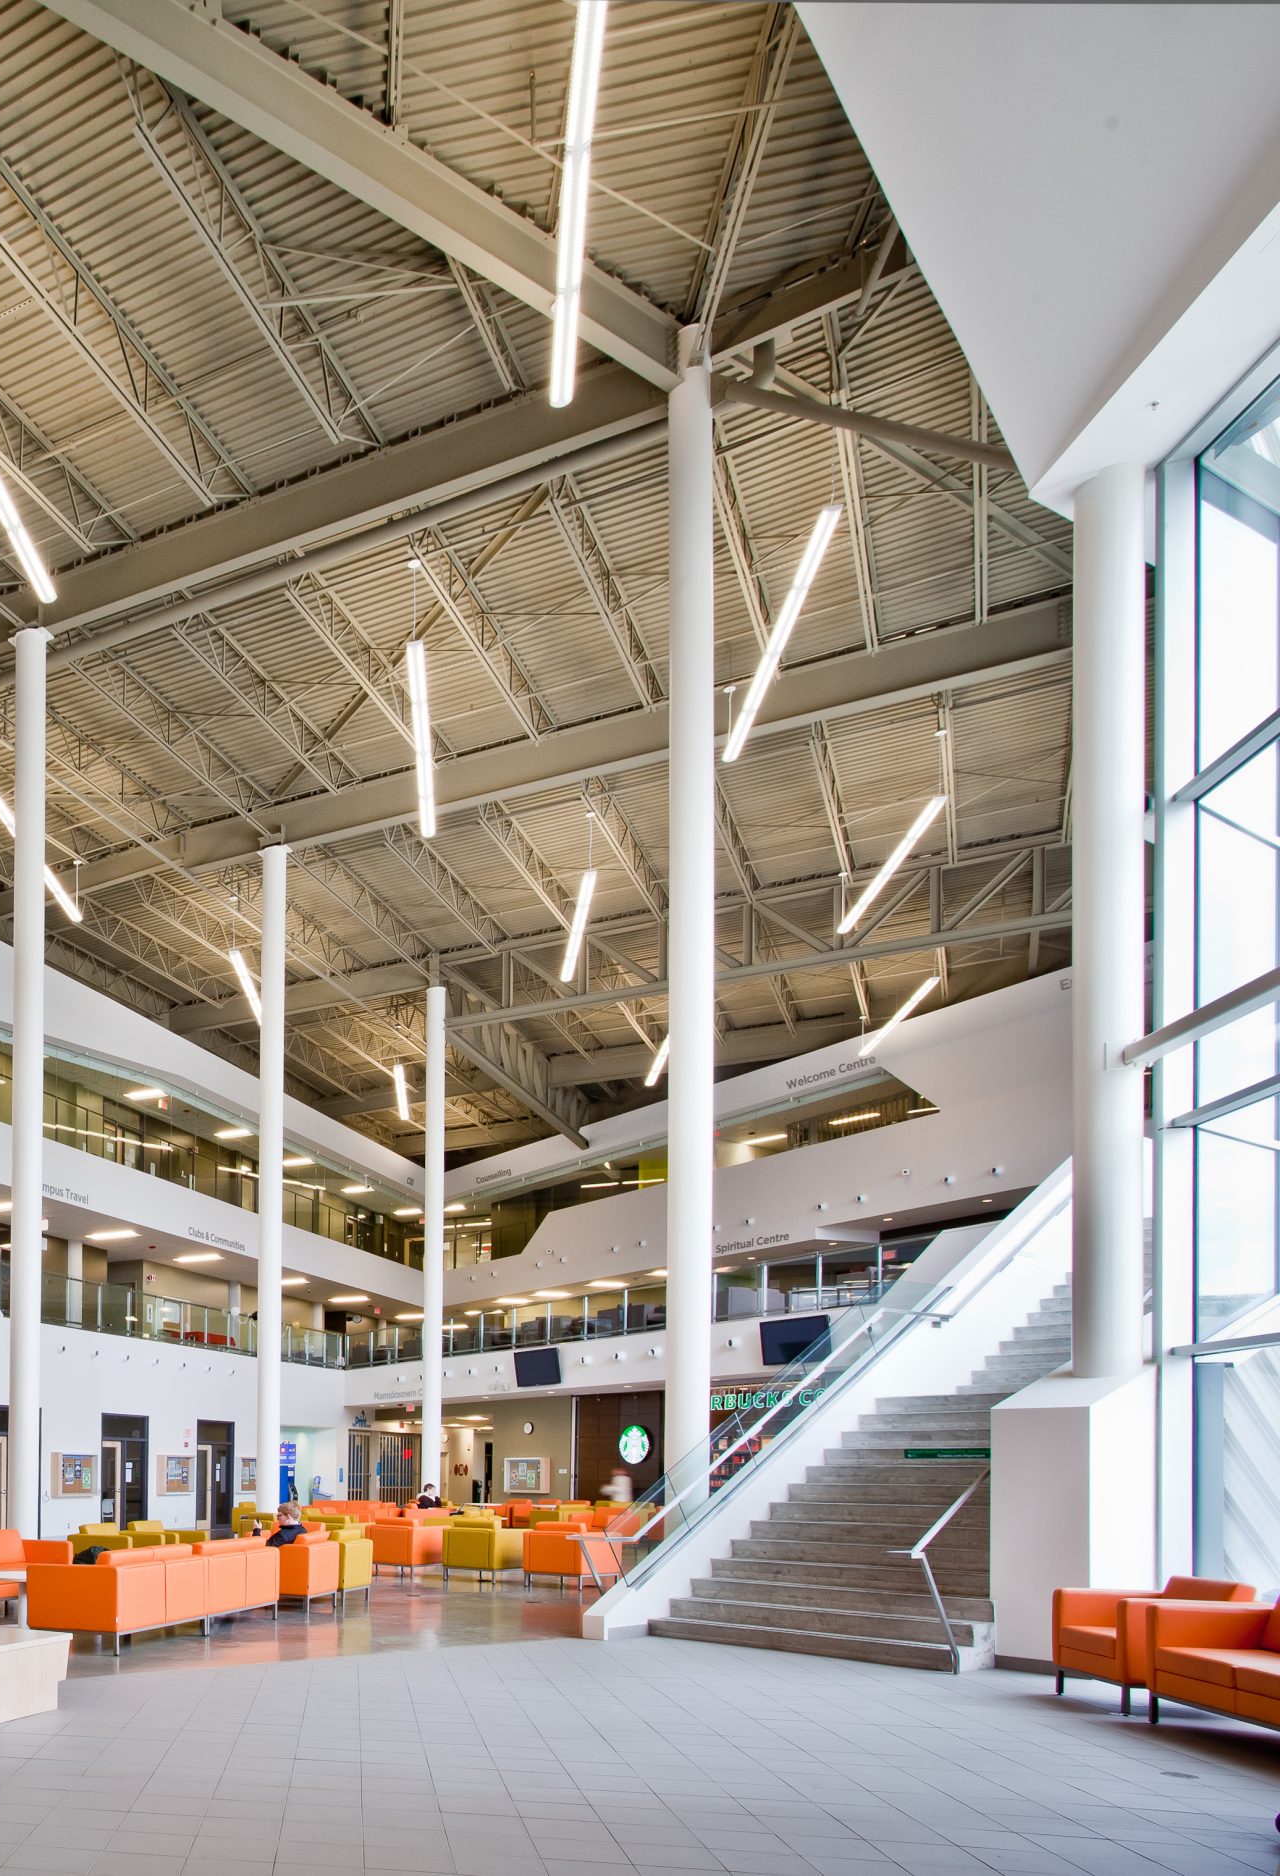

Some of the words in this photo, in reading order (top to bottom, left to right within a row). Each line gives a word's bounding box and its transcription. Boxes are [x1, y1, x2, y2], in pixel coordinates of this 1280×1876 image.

[785, 1067, 836, 1090] Welcome
[838, 1056, 877, 1074] Centre
[475, 1168, 512, 1184] Counselling
[65, 1188, 89, 1205] Travel
[188, 1226, 205, 1240] Clubs
[205, 1231, 210, 1241] &
[210, 1233, 246, 1251] Communities
[715, 1238, 754, 1254] Spiritual
[756, 1233, 790, 1246] Centre
